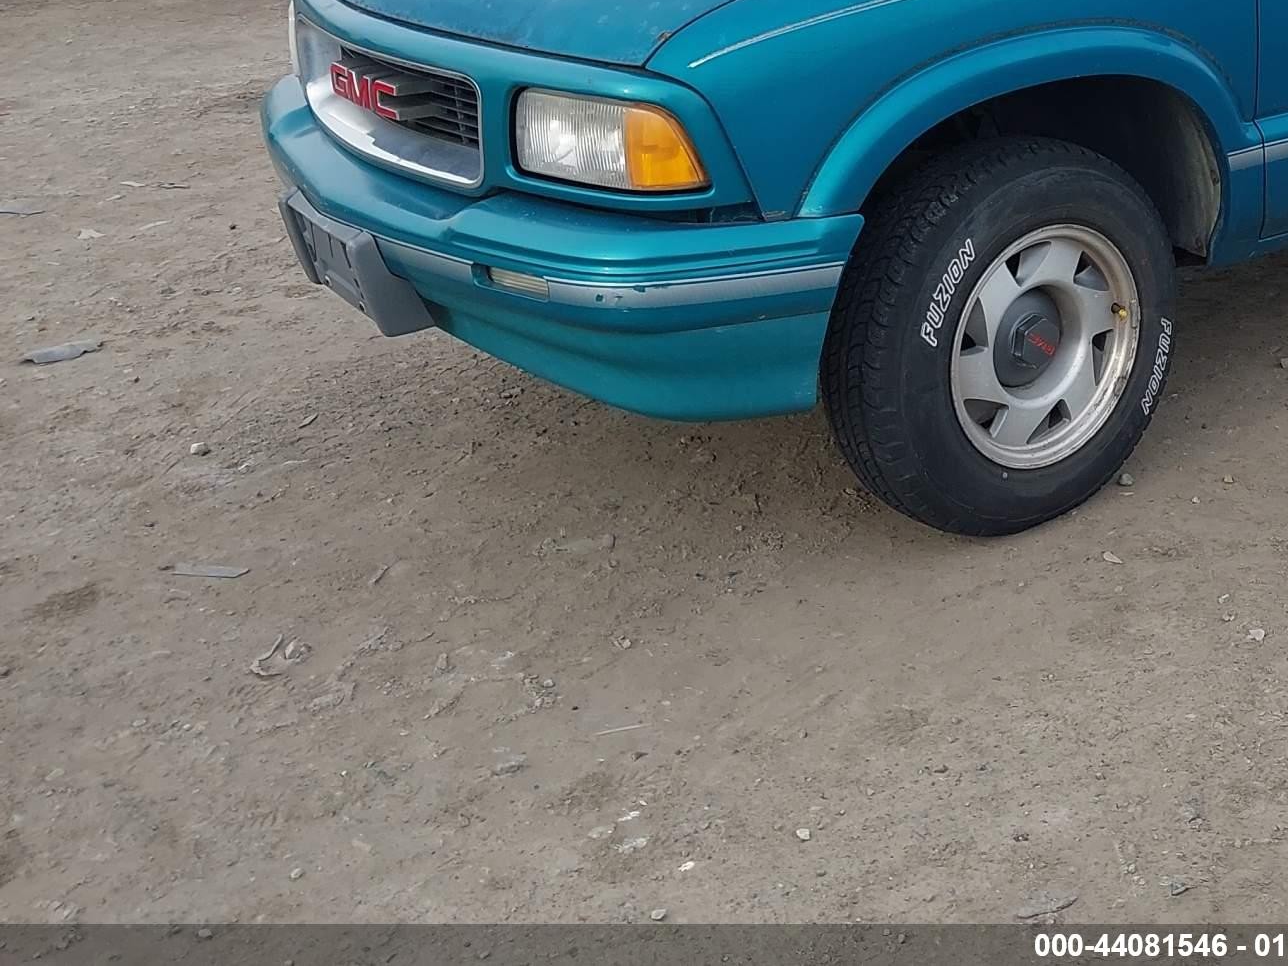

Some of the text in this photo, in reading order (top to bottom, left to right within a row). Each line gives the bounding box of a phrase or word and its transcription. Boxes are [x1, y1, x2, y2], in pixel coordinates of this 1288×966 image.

[329, 60, 400, 121] GMC
[919, 238, 977, 348] FUZION
[1140, 317, 1173, 416] FUZION
